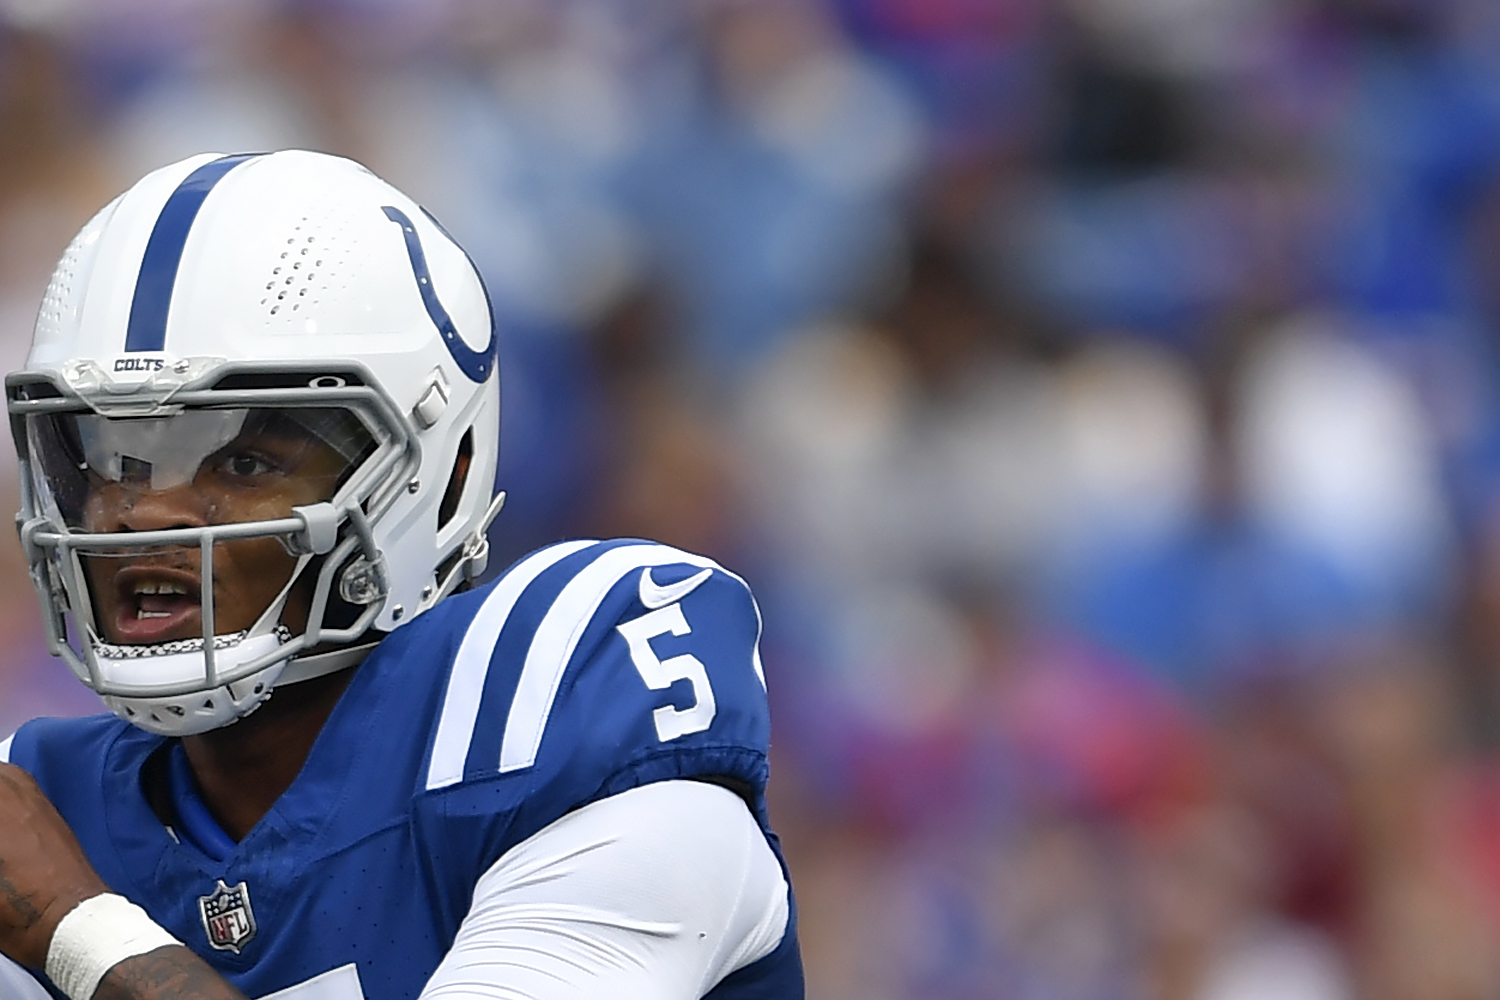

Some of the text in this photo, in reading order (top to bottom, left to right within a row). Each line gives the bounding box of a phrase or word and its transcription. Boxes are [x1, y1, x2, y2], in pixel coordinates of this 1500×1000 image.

[113, 358, 165, 372] COLTS
[616, 602, 716, 742] 5
[212, 911, 248, 941] NFL
